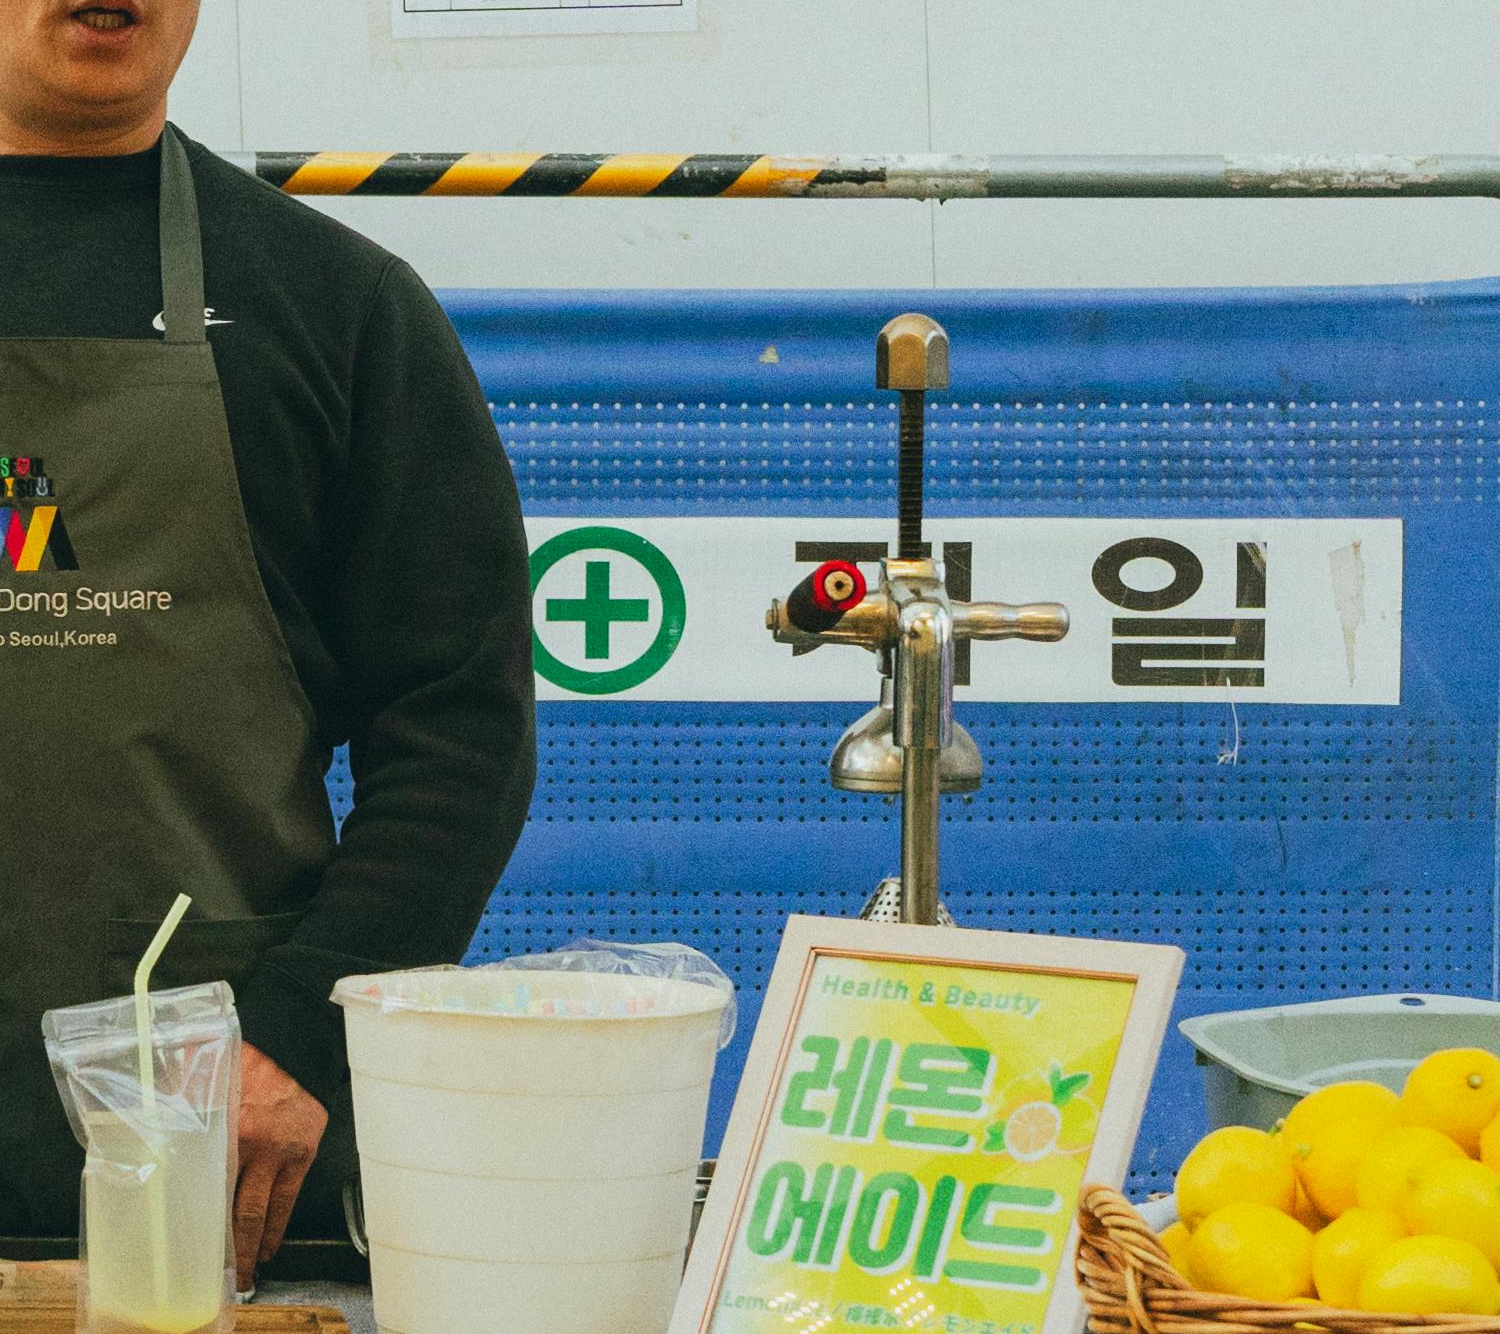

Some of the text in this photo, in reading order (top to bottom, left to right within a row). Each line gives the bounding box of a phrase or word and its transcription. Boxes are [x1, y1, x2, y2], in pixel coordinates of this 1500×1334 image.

[75, 587, 172, 615] Square
[9, 630, 117, 648] Seoul,Korea
[820, 973, 1041, 1019] Health & Beauty
[779, 1033, 996, 1152] 레몬
[744, 1159, 1065, 1295] 에이드
